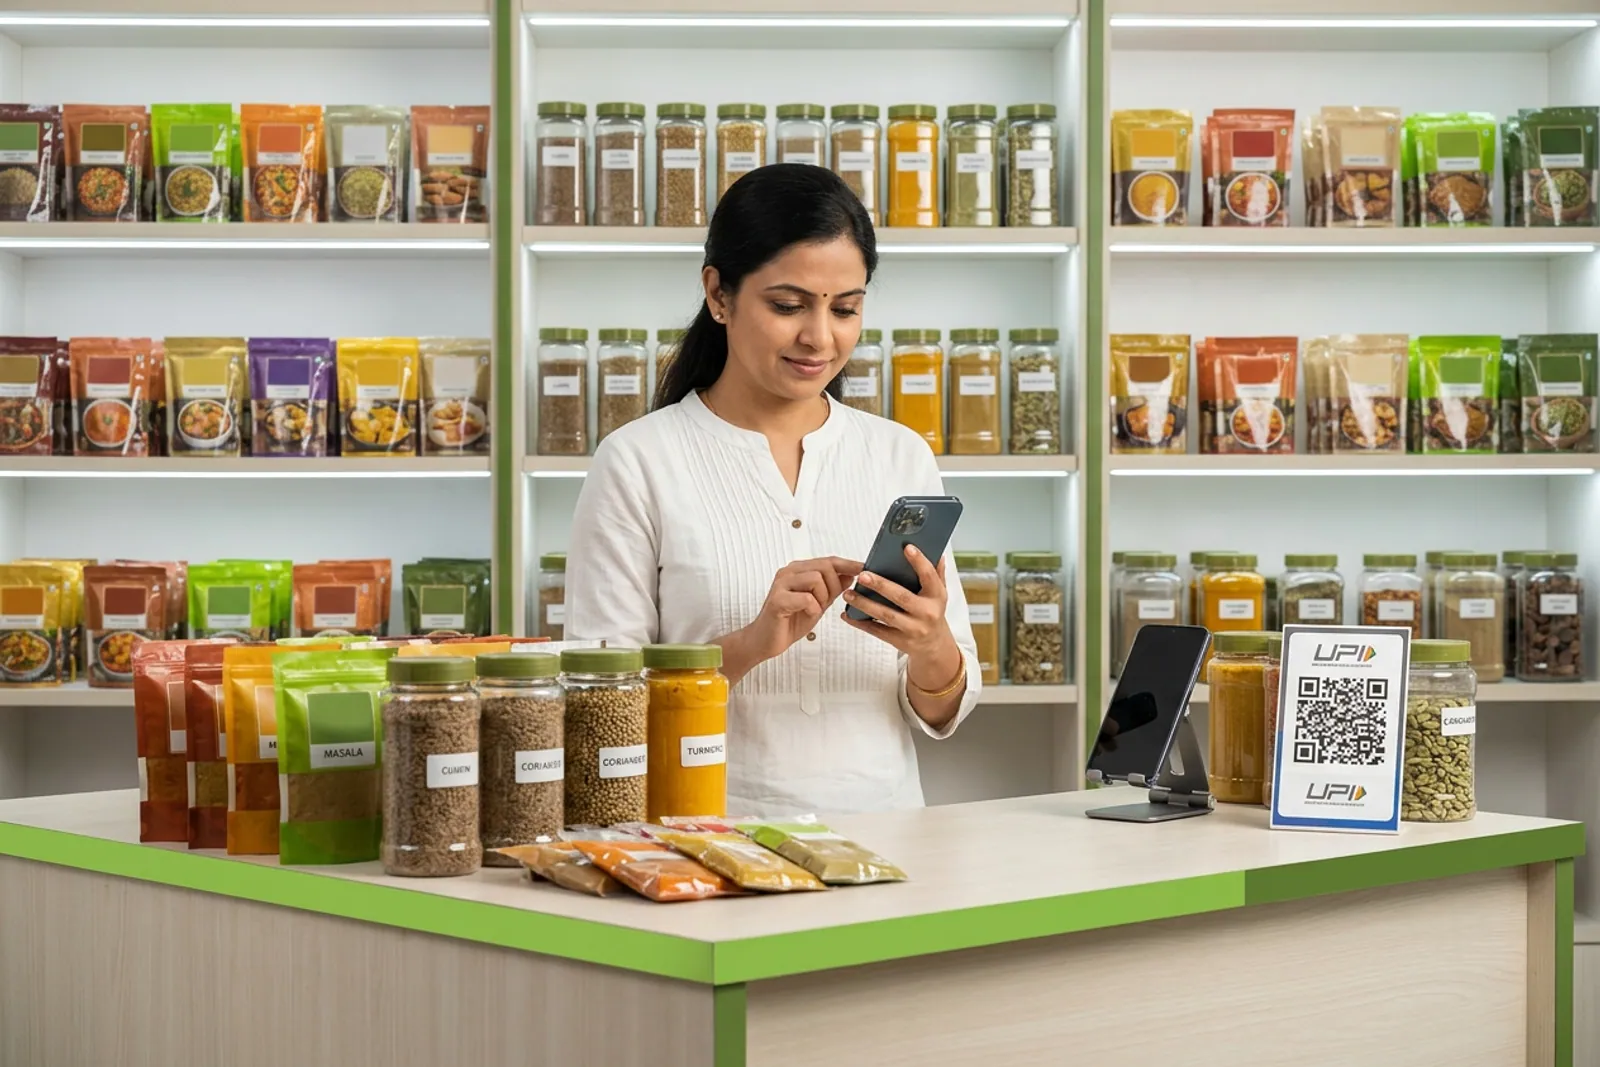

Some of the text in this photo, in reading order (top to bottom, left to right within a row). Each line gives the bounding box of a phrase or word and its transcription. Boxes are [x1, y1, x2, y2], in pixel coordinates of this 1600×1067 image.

[1314, 644, 1366, 661] UPI
[269, 741, 277, 749] M
[323, 748, 363, 759] MASALA
[1306, 783, 1356, 800] UPI
